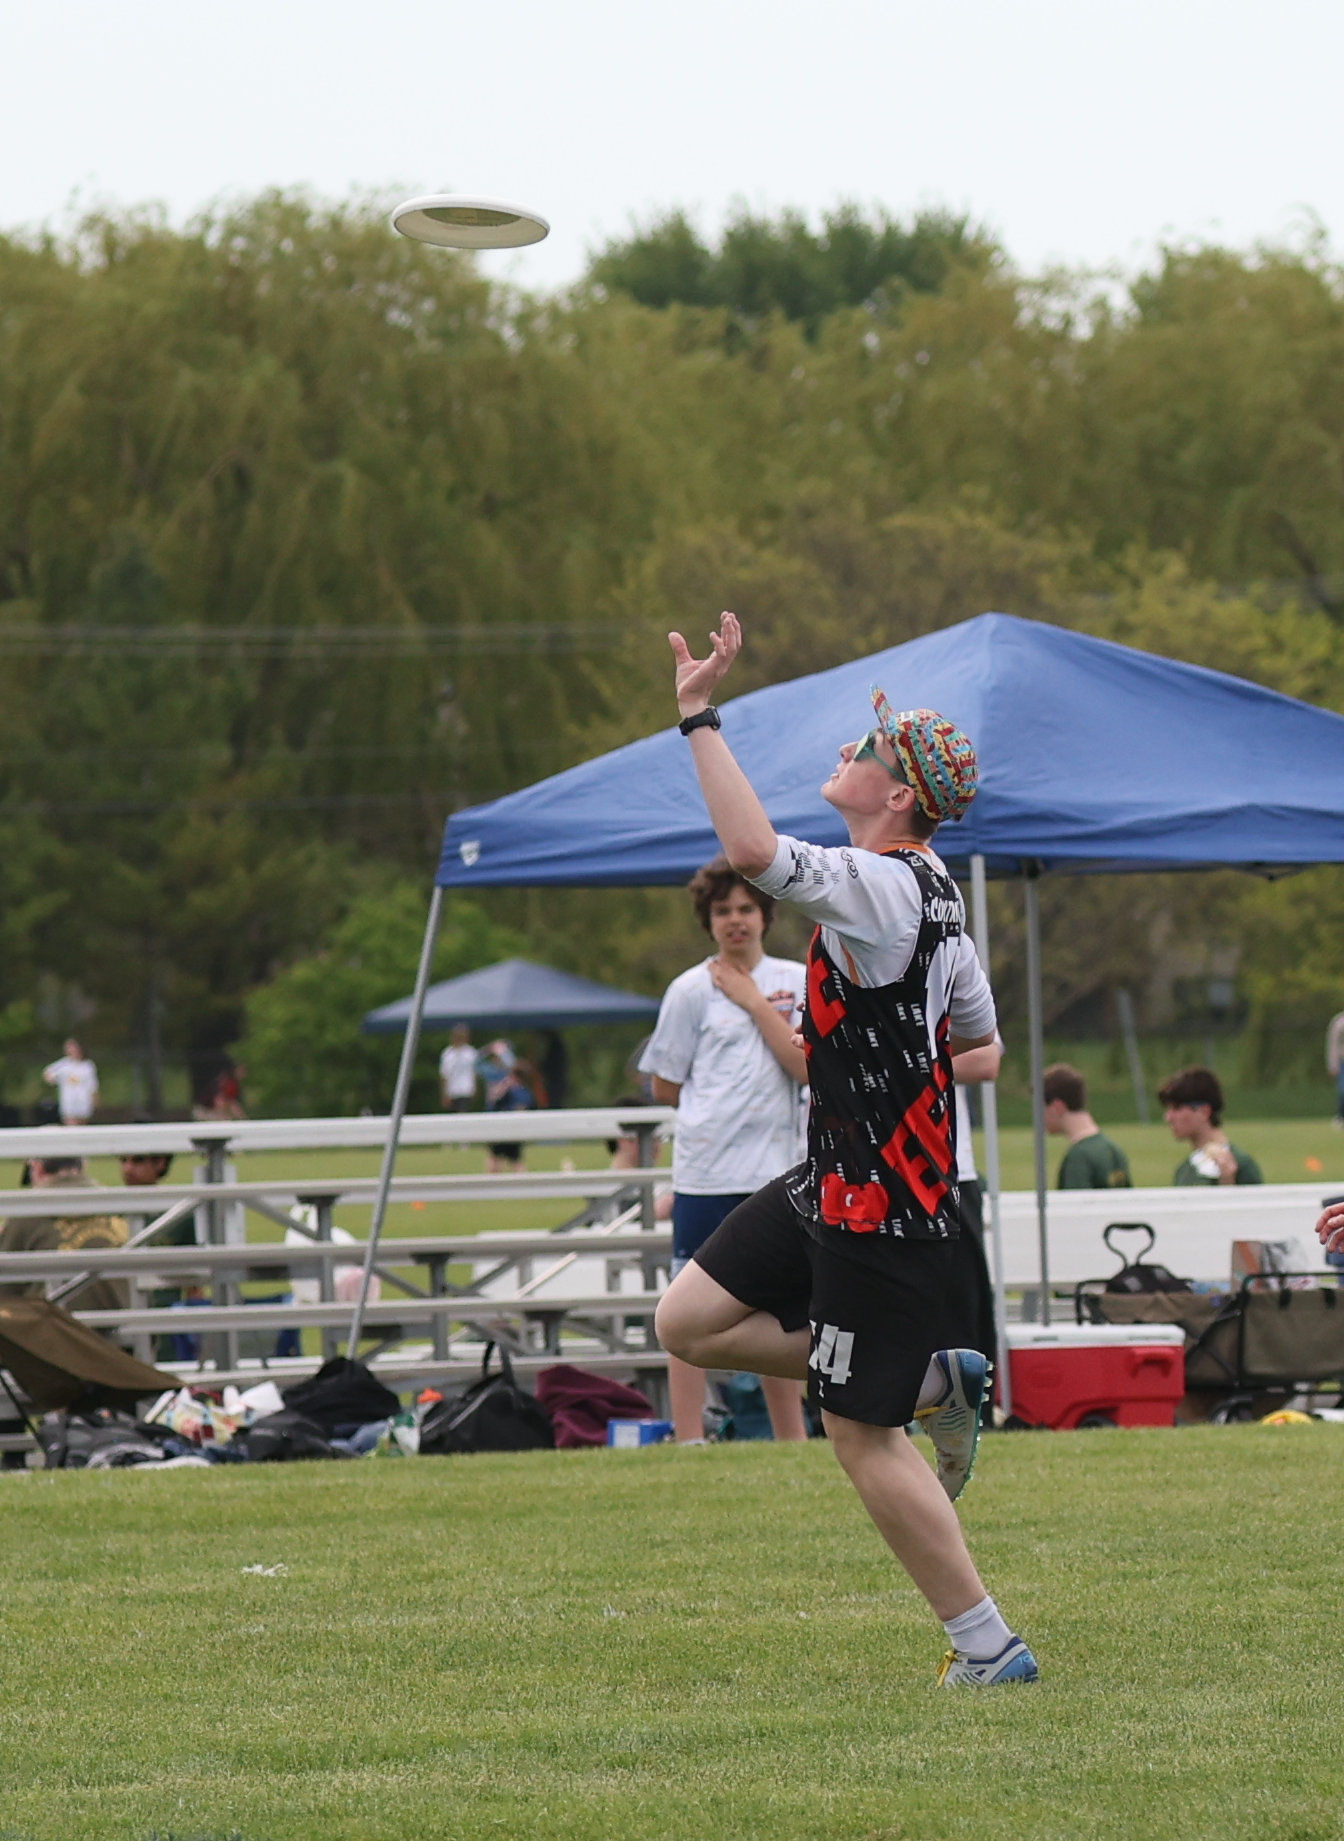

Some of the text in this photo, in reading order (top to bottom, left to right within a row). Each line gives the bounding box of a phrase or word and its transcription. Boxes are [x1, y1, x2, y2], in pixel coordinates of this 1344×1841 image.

[910, 1003, 925, 1027] LAKE
[866, 1027, 880, 1048] LAKE
[916, 1051, 931, 1074] LAKE
